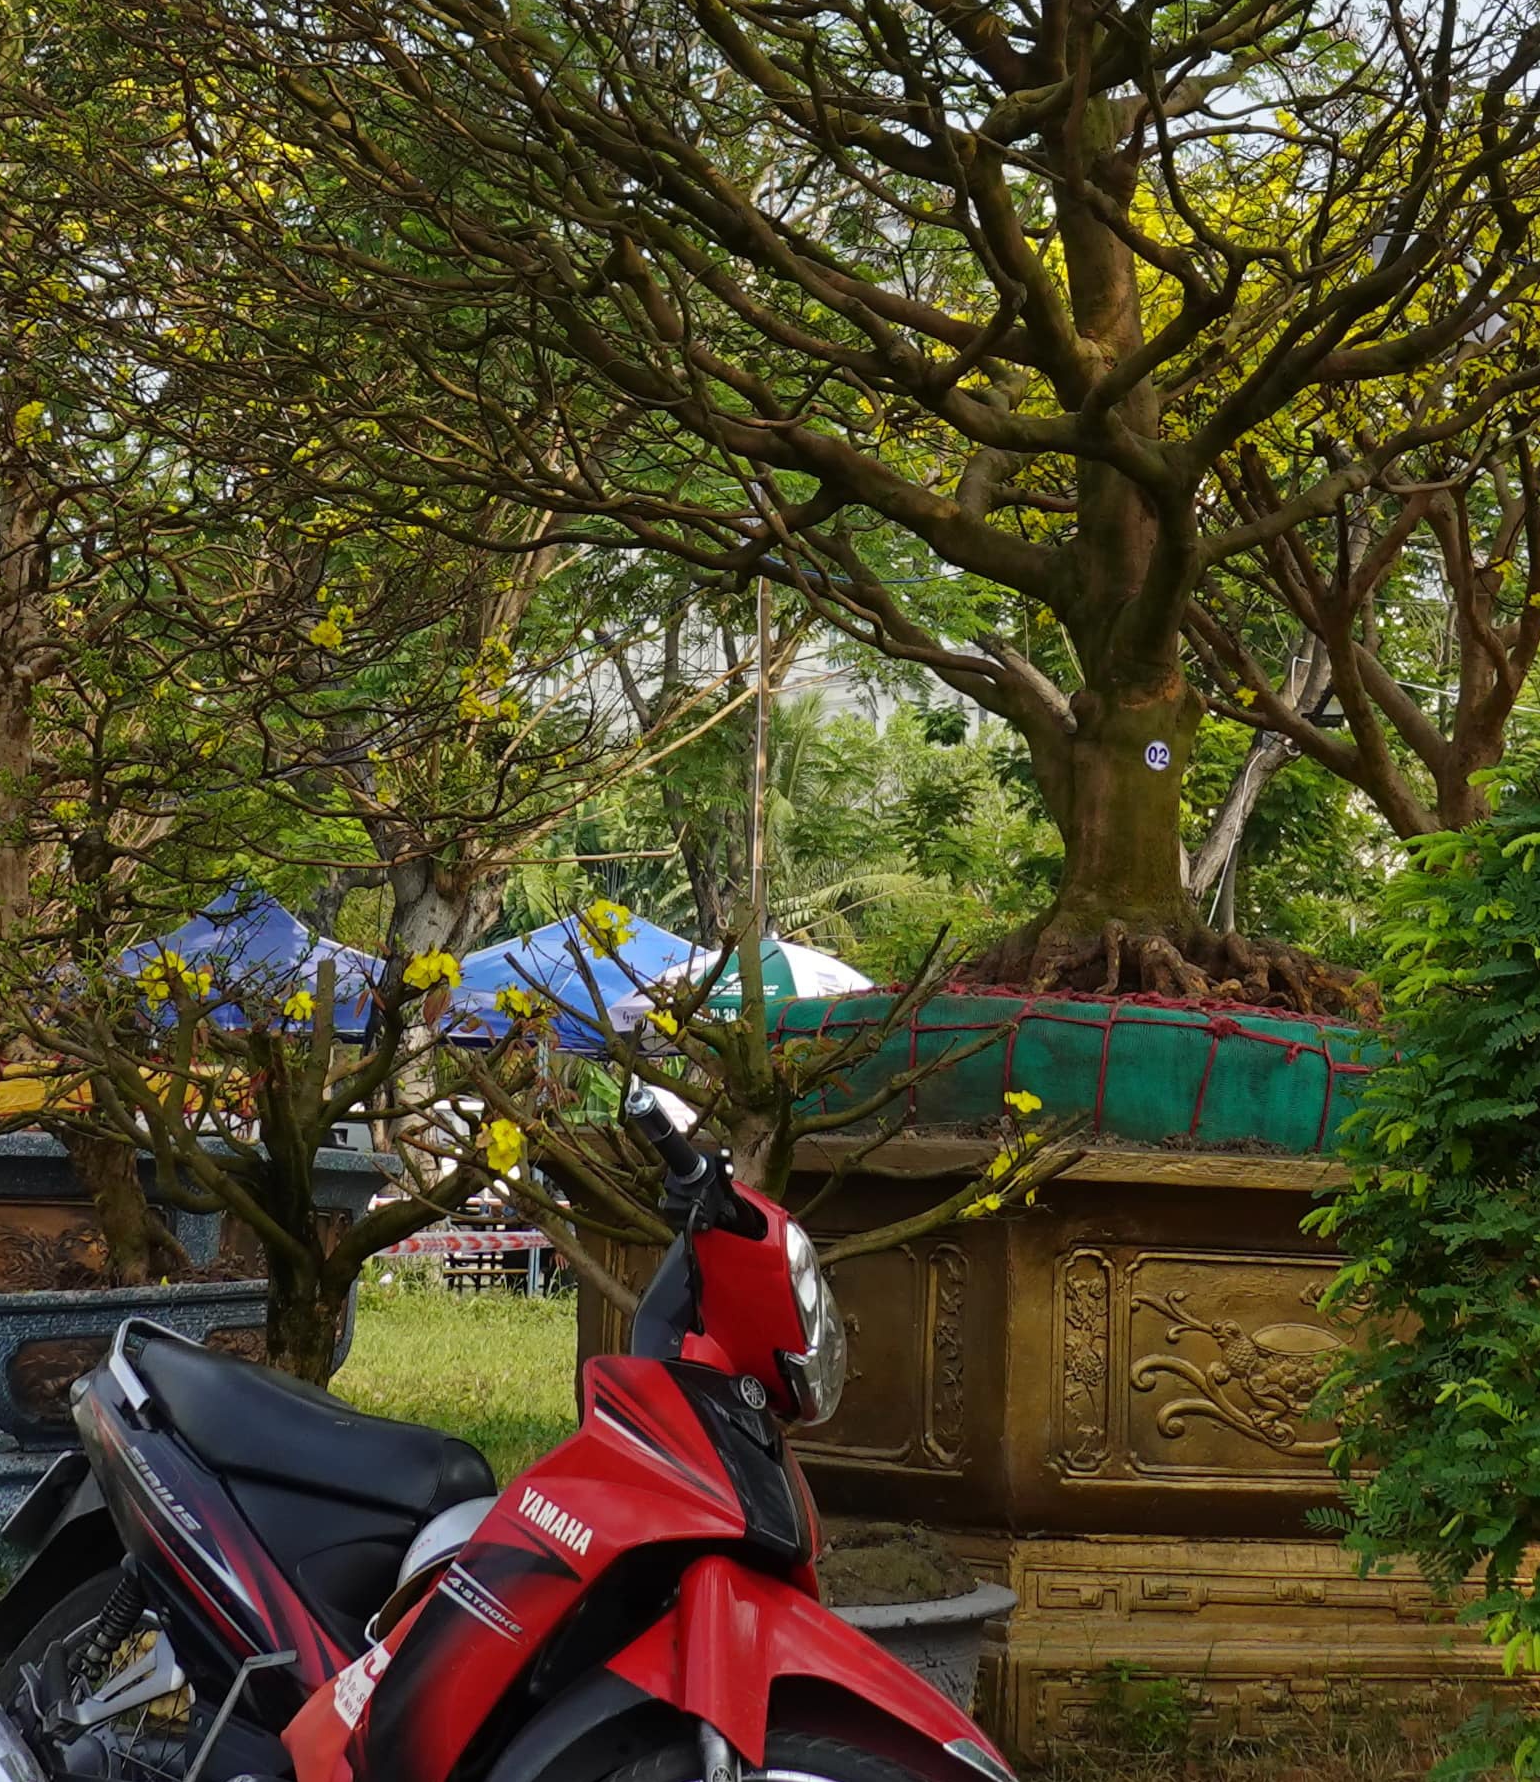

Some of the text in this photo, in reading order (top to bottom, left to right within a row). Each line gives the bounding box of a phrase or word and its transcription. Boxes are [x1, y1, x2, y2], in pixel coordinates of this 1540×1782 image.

[1148, 746, 1168, 765] 02
[125, 1446, 202, 1530] SIRIUS
[518, 1486, 594, 1557] YAMAHA
